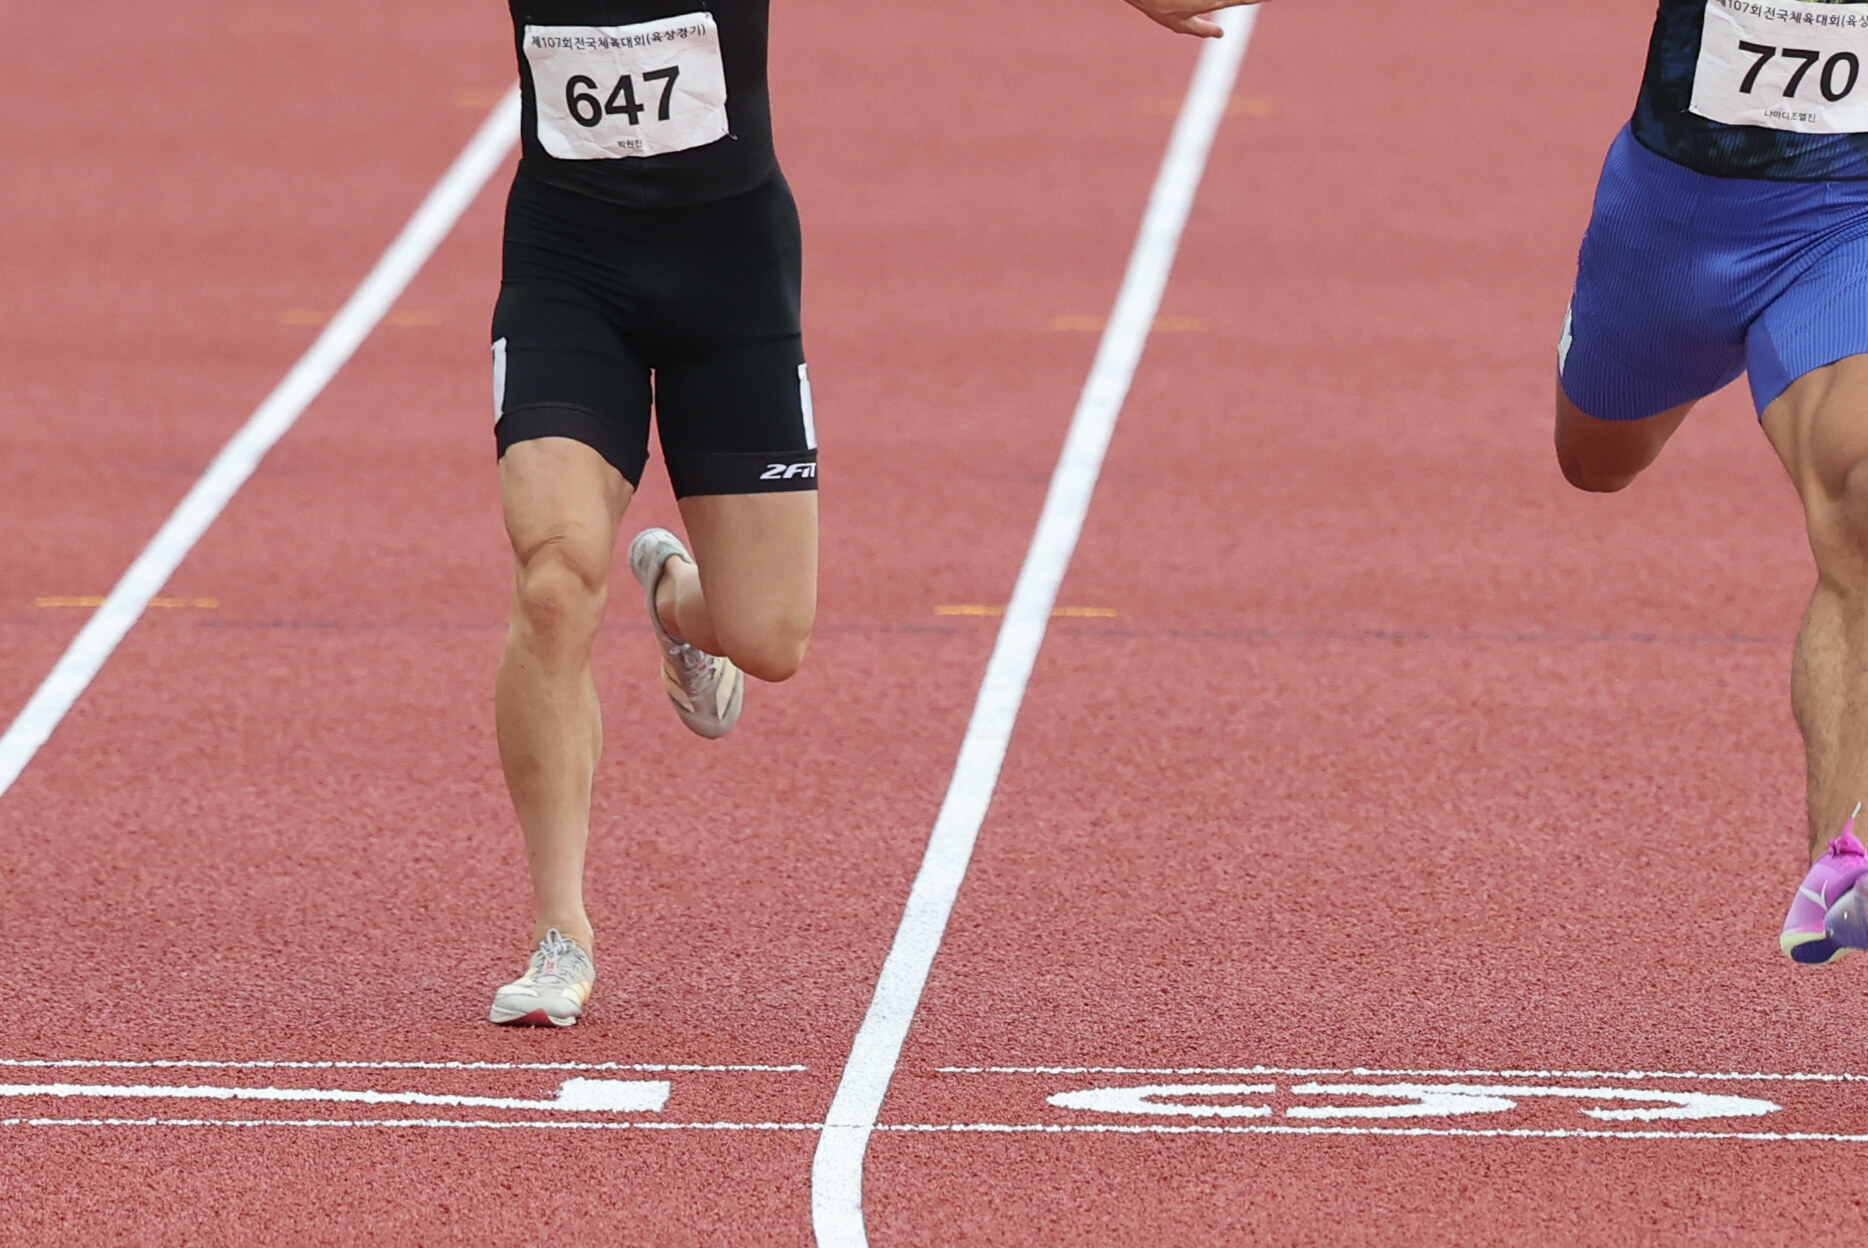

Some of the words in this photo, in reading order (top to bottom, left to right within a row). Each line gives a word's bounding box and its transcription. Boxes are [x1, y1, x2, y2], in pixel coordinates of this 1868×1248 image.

[565, 65, 680, 128] 647
[1738, 39, 1860, 102] 770
[1044, 1083, 1782, 1121] 6
